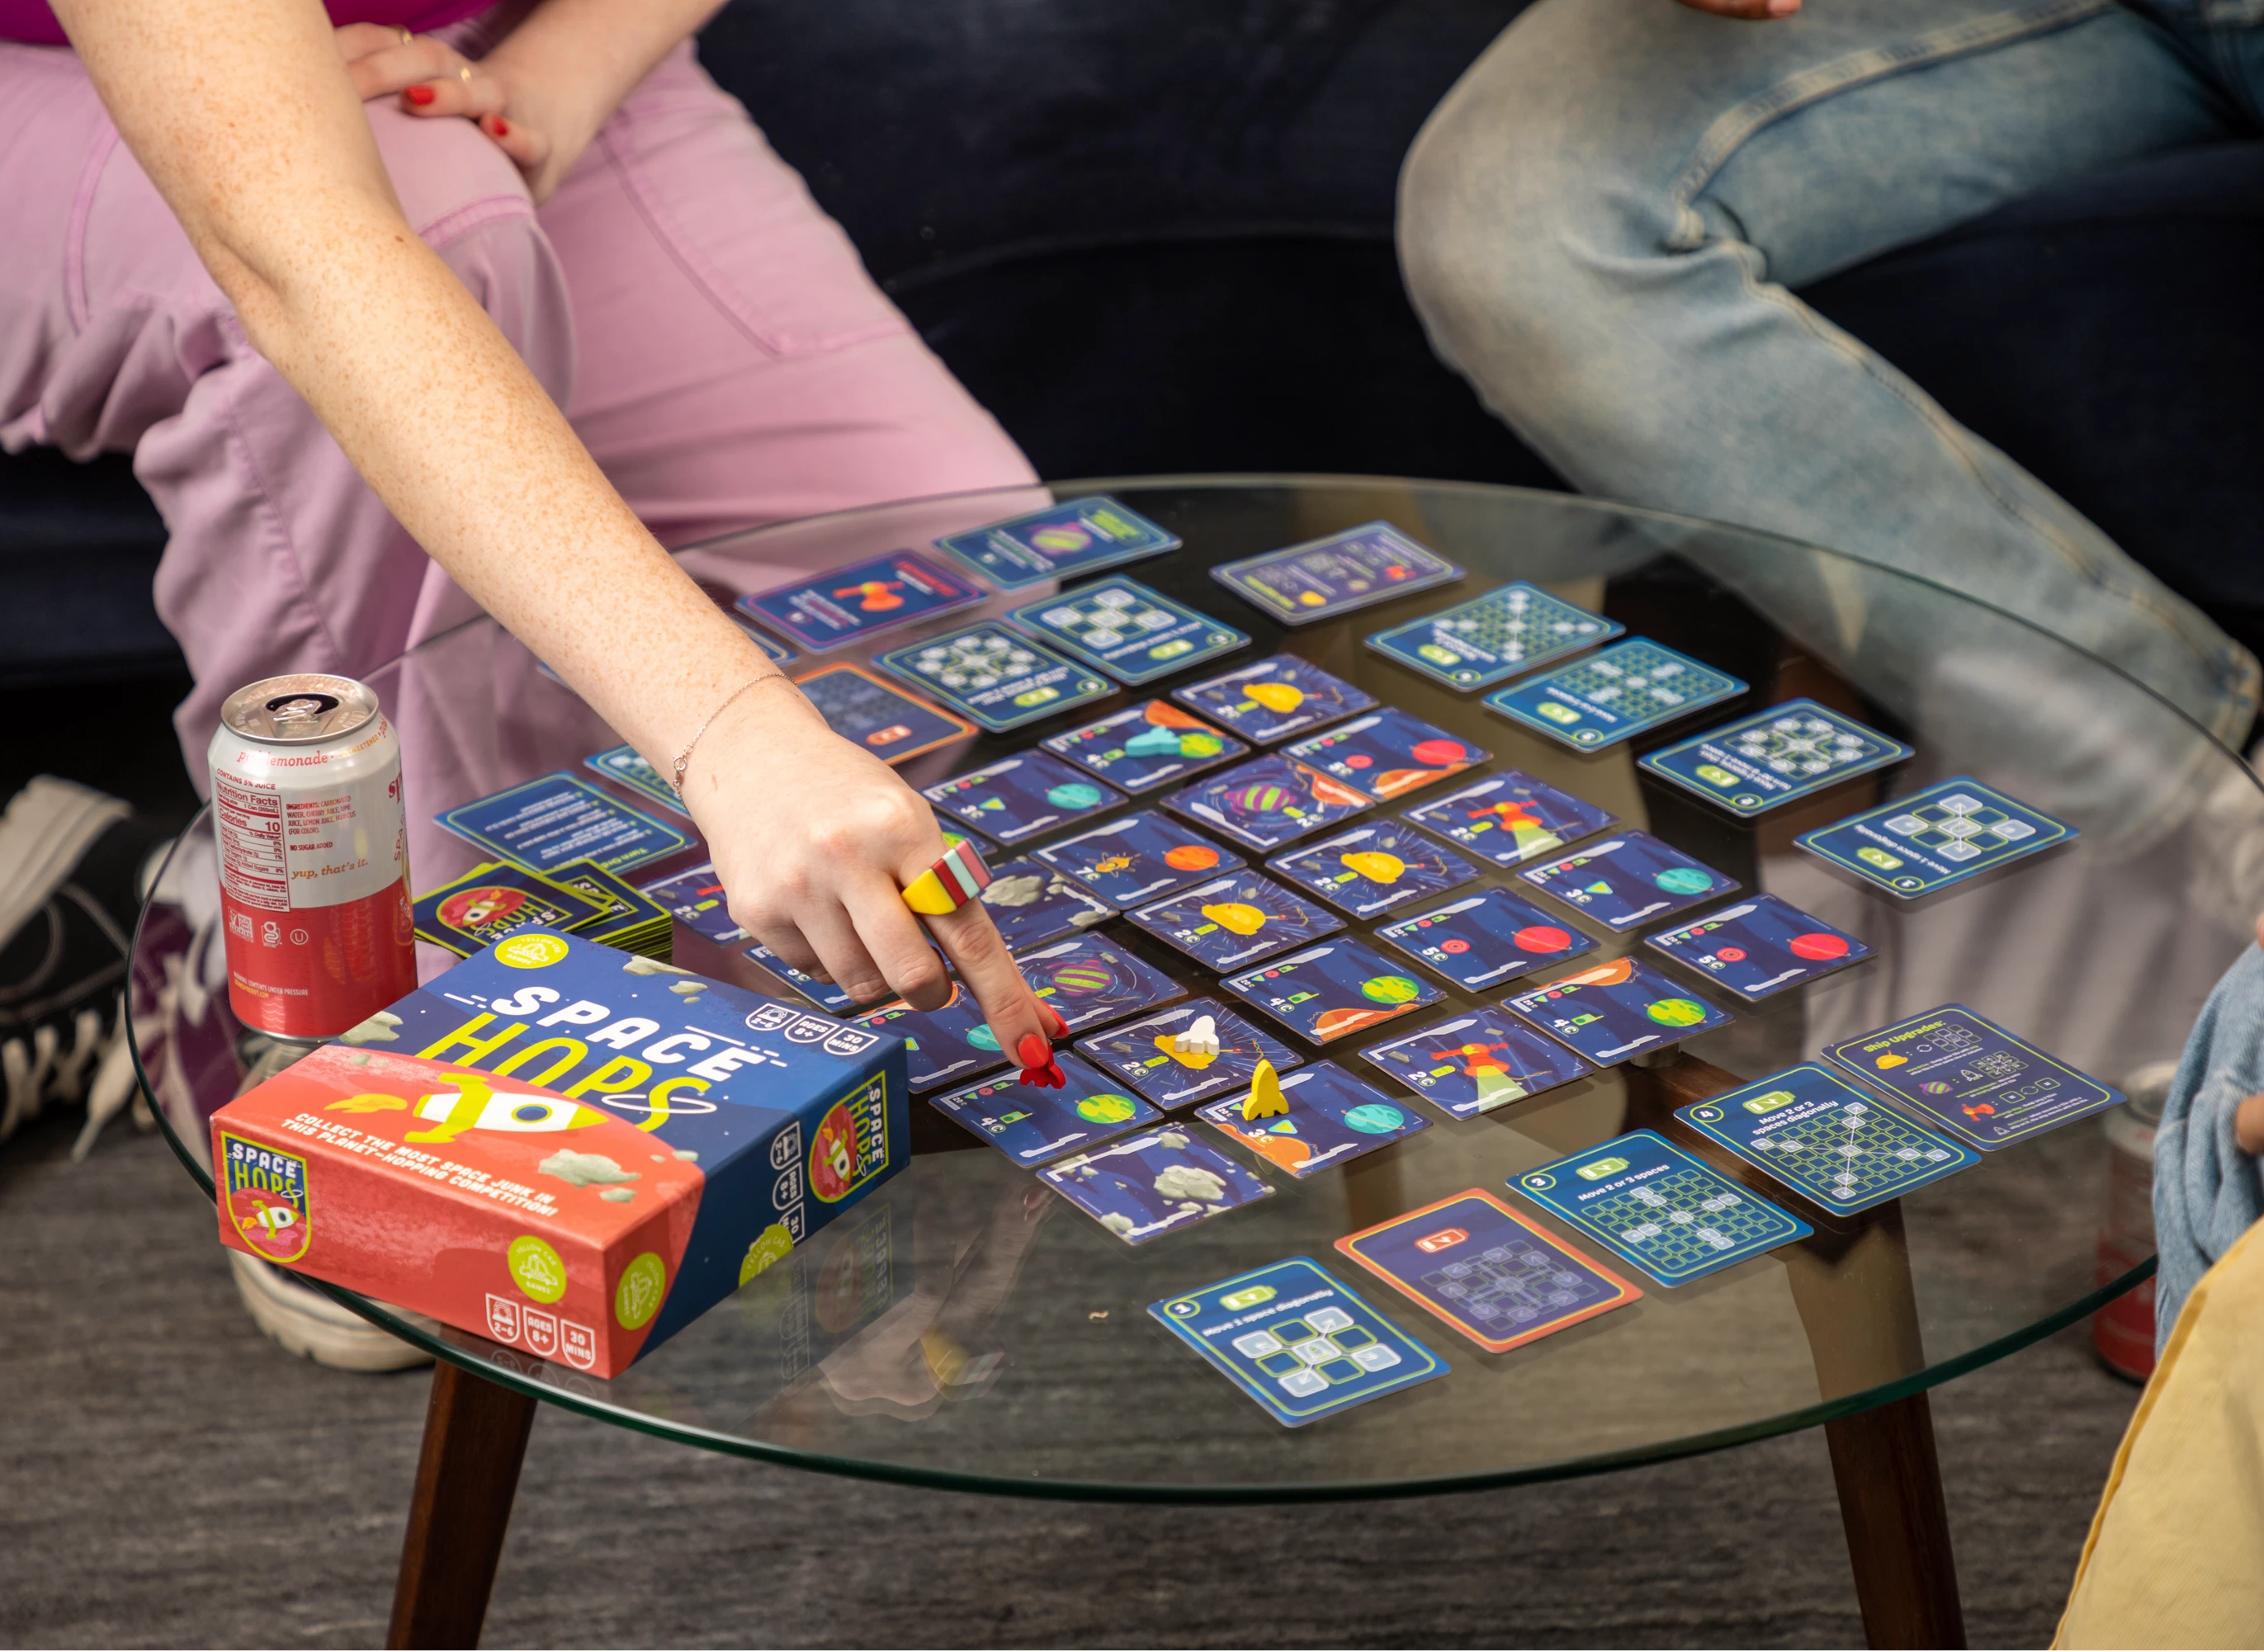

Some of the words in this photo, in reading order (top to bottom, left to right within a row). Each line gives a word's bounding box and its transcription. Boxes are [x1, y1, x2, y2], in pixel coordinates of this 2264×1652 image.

[337, 734, 379, 758] UNSWEETENED
[216, 767, 243, 785] CONTAINS
[243, 779, 253, 787] 5%
[216, 781, 248, 802] Nutrition
[250, 795, 278, 806] Facts
[320, 795, 352, 807] CARBONATED
[336, 810, 356, 822] HIBISCUS
[341, 804, 352, 812] LIME
[220, 808, 248, 827] Calories
[265, 821, 281, 832] 10
[1854, 824, 1898, 848] diagonally
[1896, 845, 1923, 860] space
[291, 870, 319, 880] yup,
[321, 861, 355, 876] that's
[357, 858, 368, 867] it.
[1926, 860, 1952, 875] Move
[1901, 879, 1917, 888] 1
[505, 953, 532, 965] GAMES
[248, 979, 267, 991] CONTENTS
[267, 986, 284, 994] UNDER
[750, 1017, 774, 1028] 2-6
[794, 1027, 815, 1037] 8+
[798, 1020, 830, 1034] AGES
[491, 986, 768, 1082] SPACE
[843, 1034, 862, 1045] 30
[1863, 1037, 1891, 1053] Ship
[1888, 1020, 1946, 1045] Upgrades:
[828, 1038, 860, 1052] MINS
[414, 1012, 716, 1133] HOPS
[1699, 1110, 1714, 1118] 4
[1752, 1119, 1789, 1136] spaces
[1787, 1099, 1840, 1124] diagonally
[1759, 1112, 1789, 1126] Move
[1795, 1104, 1808, 1112] or
[869, 1087, 883, 1163] SPACE
[848, 1095, 872, 1178] HOPS
[232, 1142, 298, 1178] SPACE
[281, 1118, 319, 1136] THIS
[316, 1130, 448, 1181] PLANET-HOPPING
[448, 1173, 559, 1217] COMPETITION!
[294, 1112, 363, 1142] COLLECT
[362, 1134, 396, 1151] THE
[394, 1143, 442, 1165] MOST
[439, 1158, 492, 1183] SPACE
[489, 1178, 536, 1197] JUNK
[533, 1192, 556, 1205] IN
[234, 1159, 304, 1210] HOPS
[789, 1170, 797, 1199] AGES
[1531, 1178, 1546, 1187] 3
[1577, 1187, 1608, 1201] Move
[1605, 1183, 1616, 1192] 2
[1614, 1180, 1627, 1188] or
[1633, 1163, 1671, 1181] spaces
[790, 1215, 800, 1234] 30
[517, 1244, 543, 1254] YELLOW
[542, 1249, 557, 1267] CAB
[746, 1238, 772, 1270] YELLOW
[772, 1235, 786, 1248] CAB
[646, 1260, 660, 1286] YELLOW
[526, 1281, 551, 1295] GAMES
[1175, 1302, 1192, 1315] 1
[1201, 1321, 1236, 1337] Move
[1233, 1318, 1244, 1326] 1
[1241, 1307, 1277, 1323] space
[1275, 1288, 1335, 1312] diagonally
[494, 1322, 514, 1337] 2-6
[527, 1315, 553, 1333] AGES
[532, 1329, 550, 1345] 8+
[570, 1331, 586, 1346] 30
[565, 1344, 593, 1360] MINS
